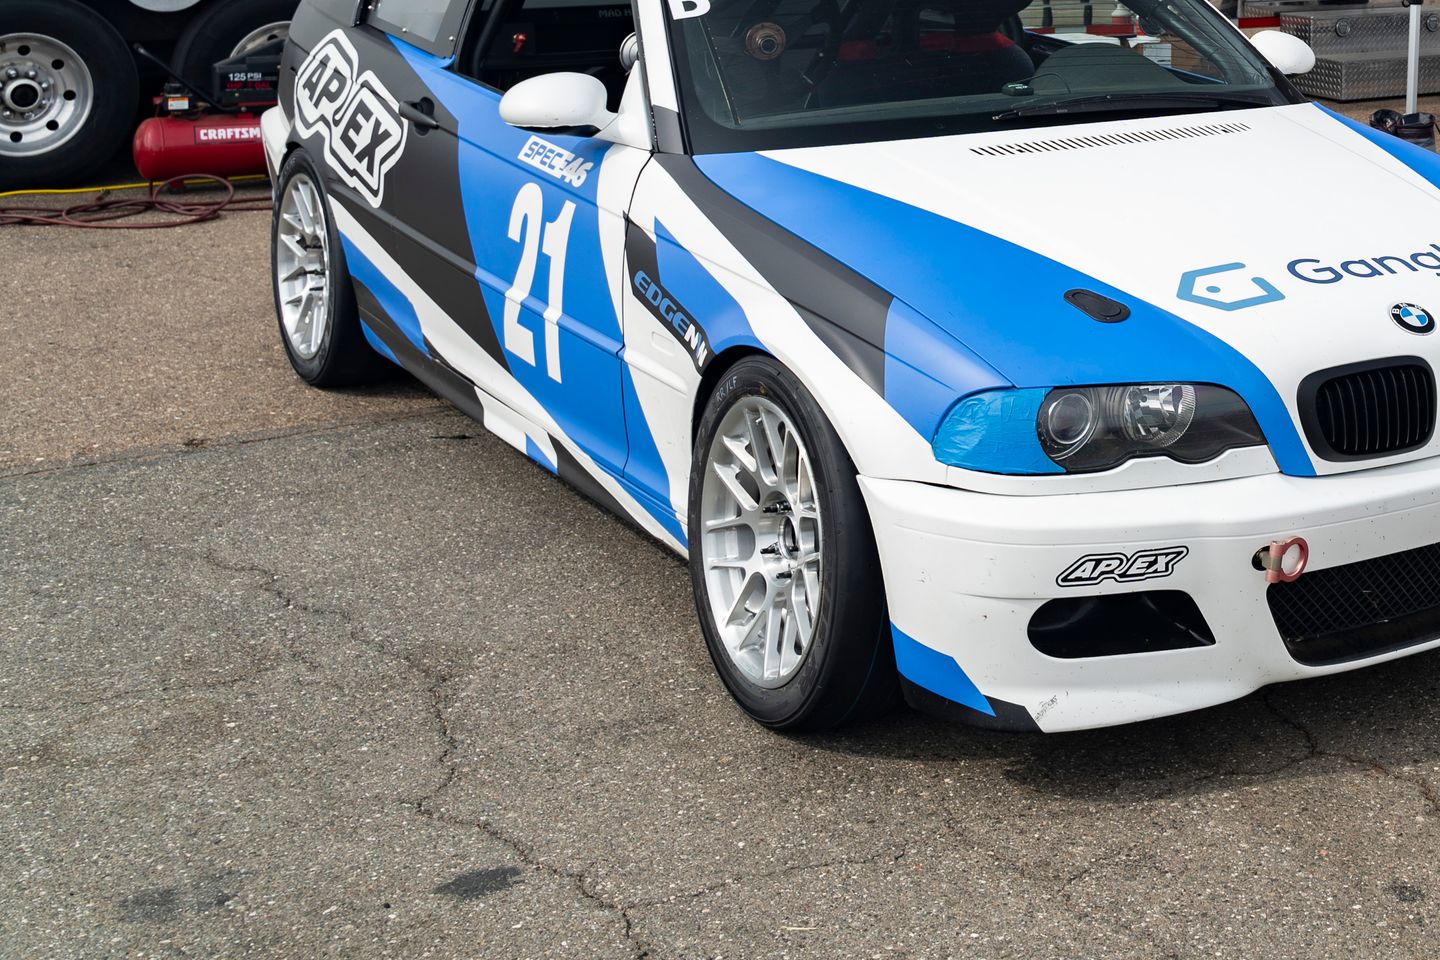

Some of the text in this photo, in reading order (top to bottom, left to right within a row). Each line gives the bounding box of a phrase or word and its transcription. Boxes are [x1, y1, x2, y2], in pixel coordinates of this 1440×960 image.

[228, 72, 262, 82] 125 PSI
[200, 127, 261, 140] CRAFTSM
[298, 42, 401, 192] APEX
[503, 182, 577, 385] 21
[1061, 550, 1183, 583] APEX
